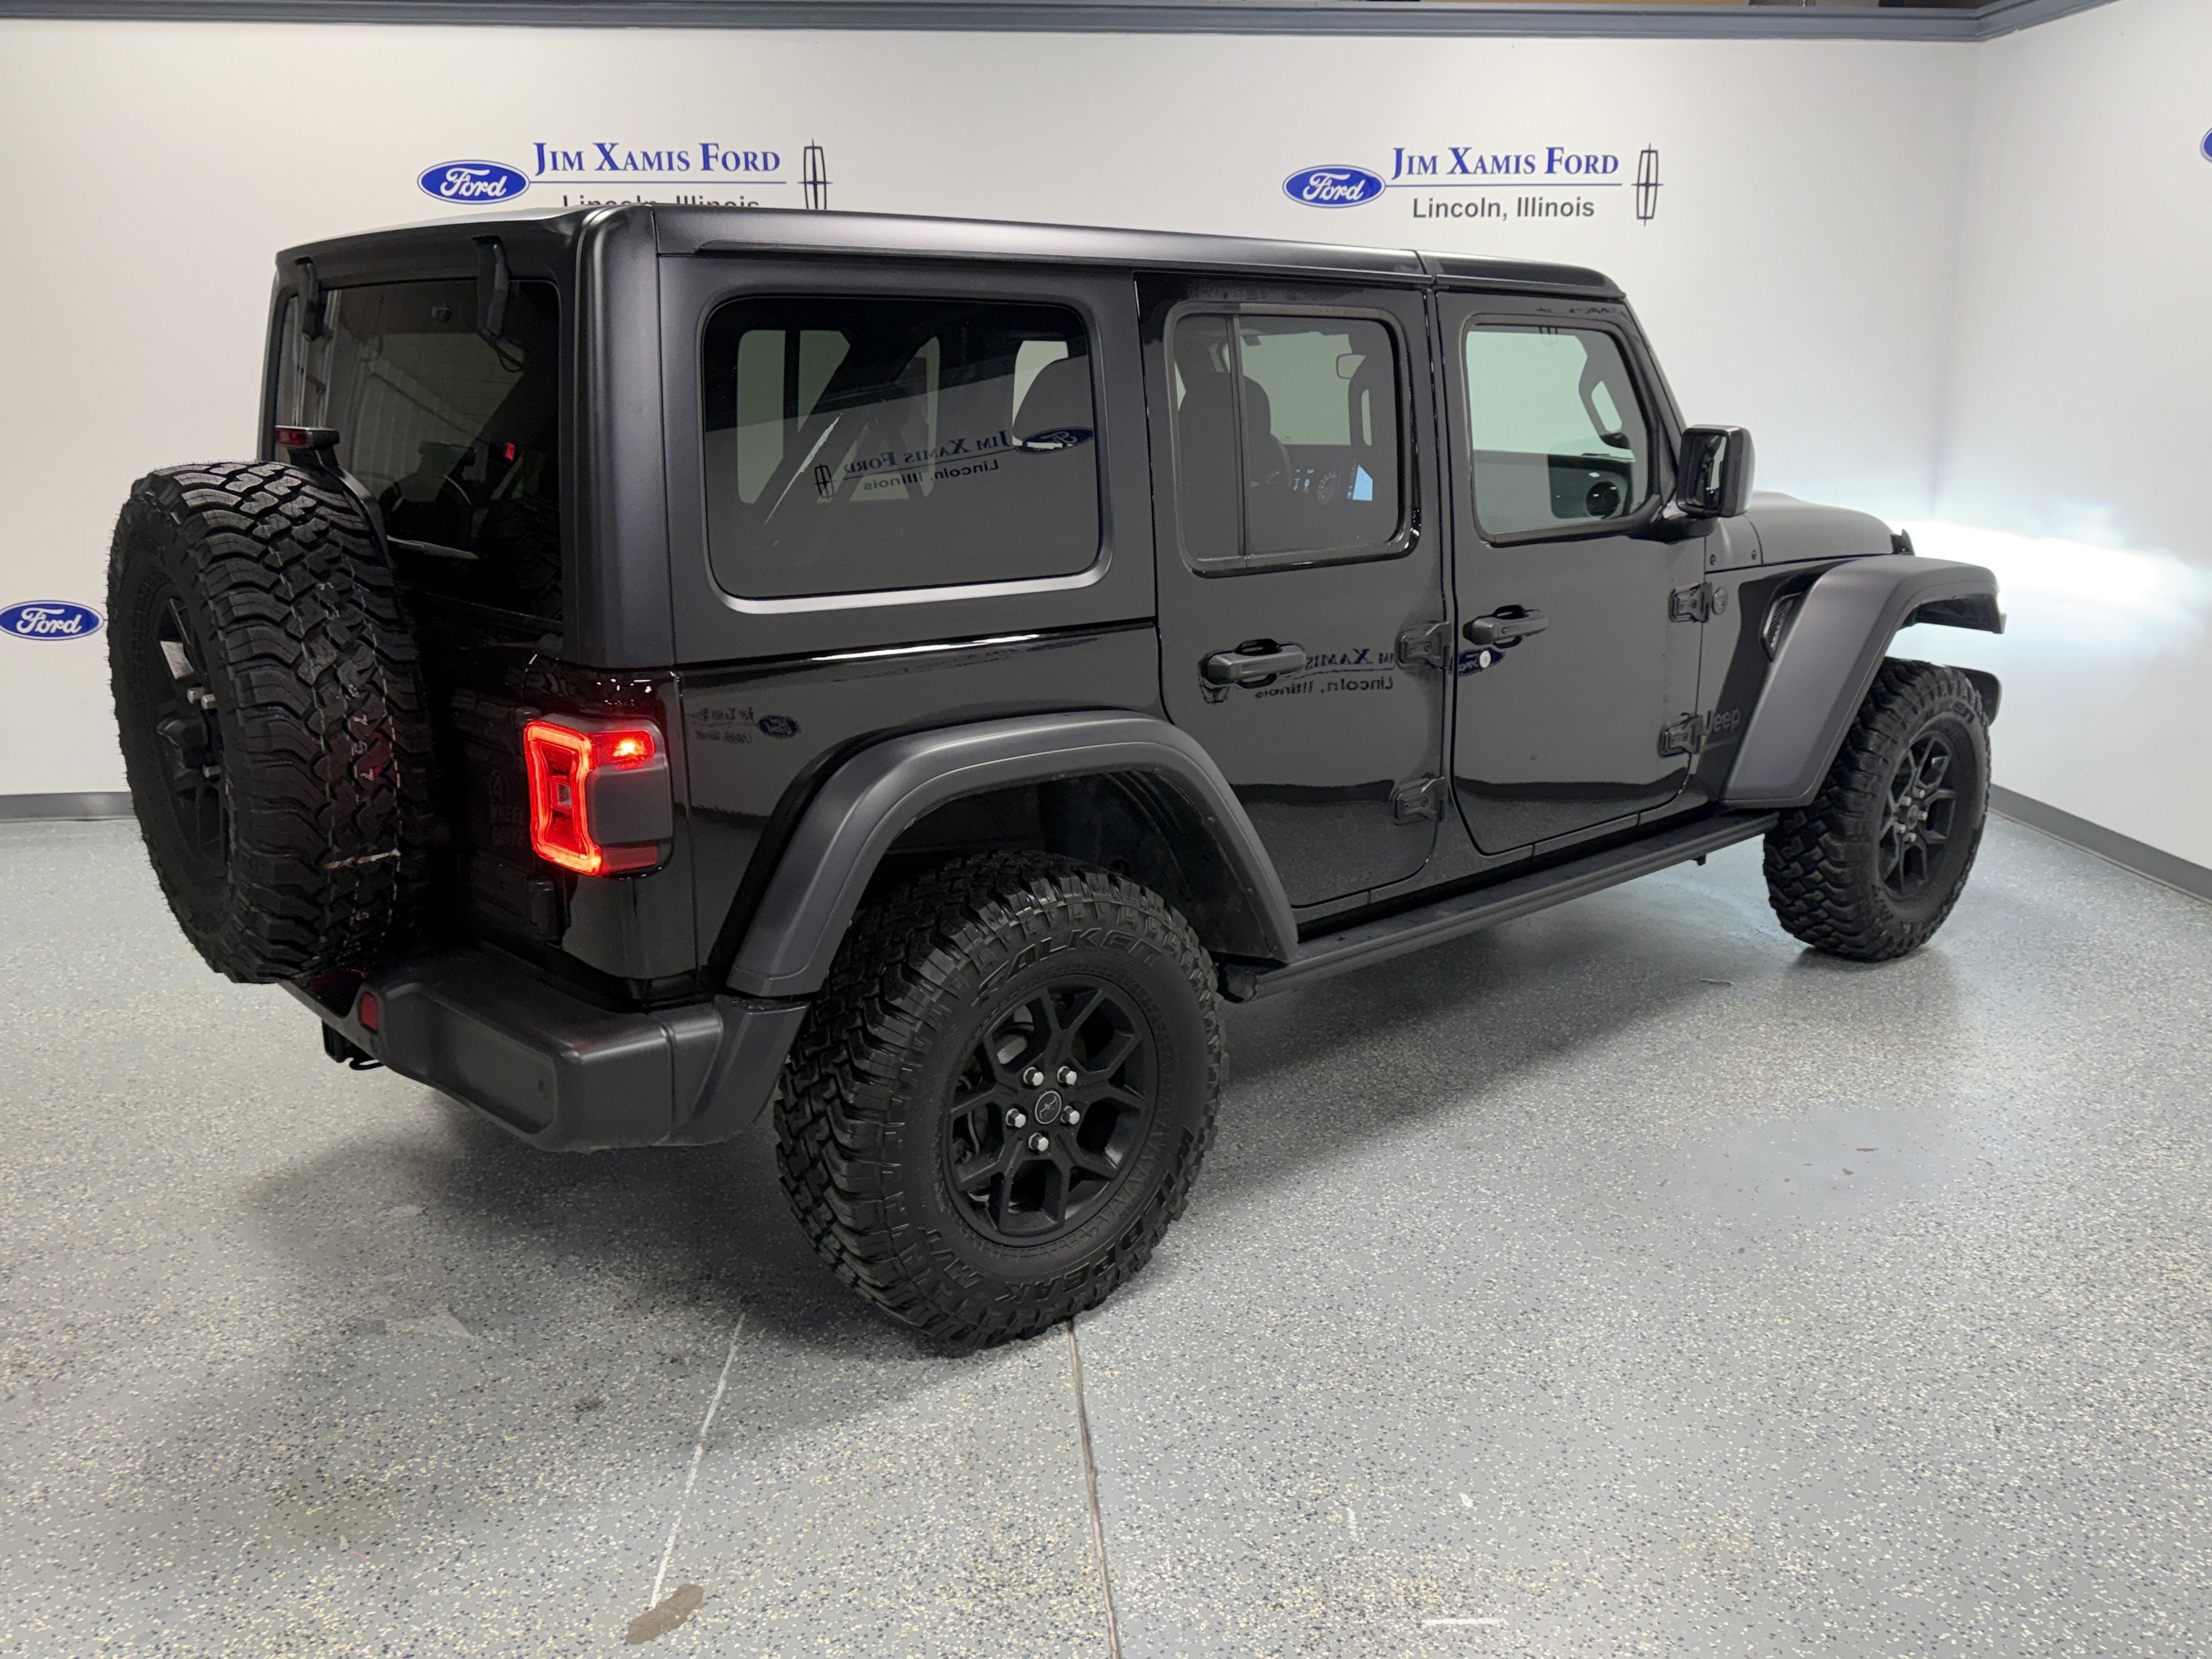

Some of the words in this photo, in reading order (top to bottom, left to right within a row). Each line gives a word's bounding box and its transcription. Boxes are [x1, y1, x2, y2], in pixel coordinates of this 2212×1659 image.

[439, 167, 506, 198] Ford
[1302, 172, 1364, 201] Ford
[1413, 197, 1508, 221] Lincoln,
[1516, 196, 1595, 218] Illinois
[16, 607, 82, 634] Ford
[1703, 709, 1741, 736] Jeep
[970, 927, 1162, 1008] FALKEN
